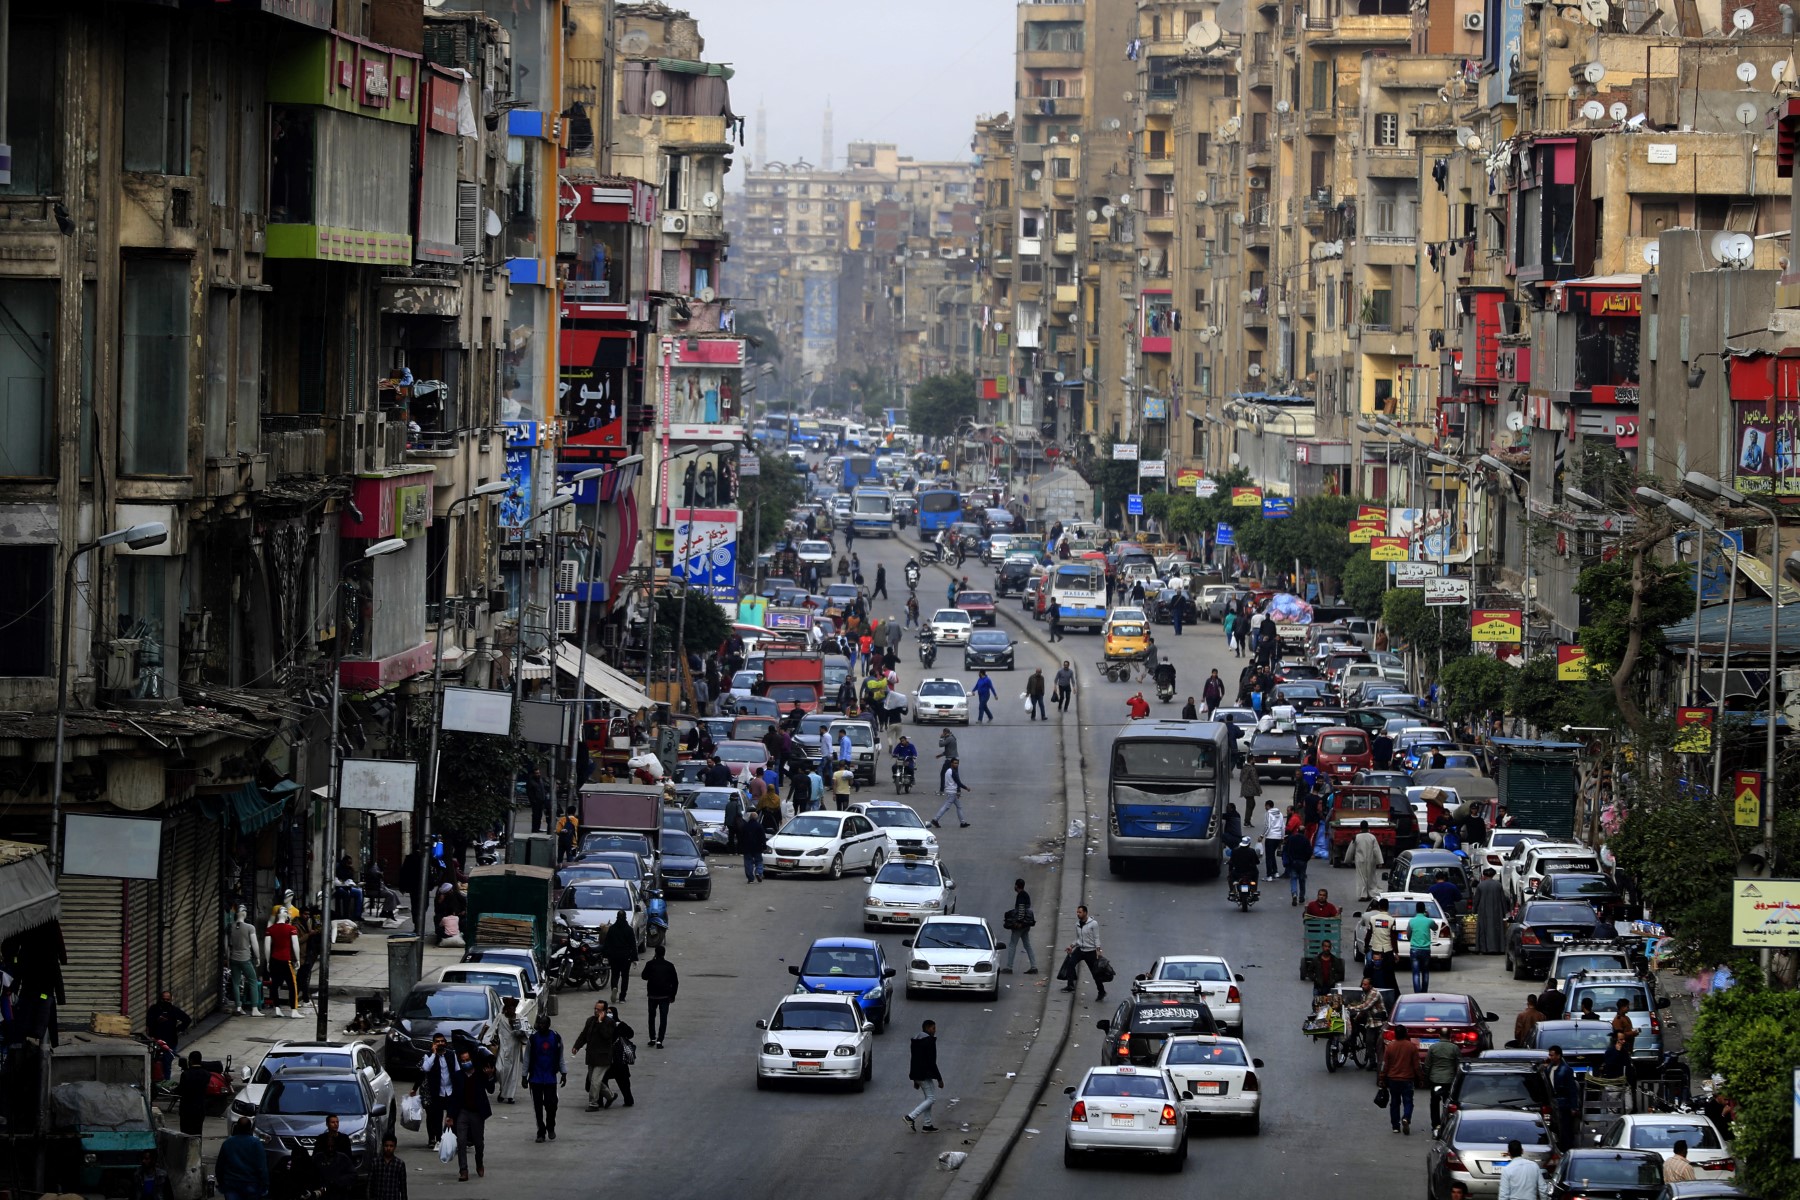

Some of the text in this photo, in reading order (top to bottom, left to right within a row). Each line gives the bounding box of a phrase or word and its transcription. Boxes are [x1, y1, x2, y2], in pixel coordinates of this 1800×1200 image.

[576, 372, 610, 408] أبو
[1426, 583, 1467, 594] أشرف راغب
